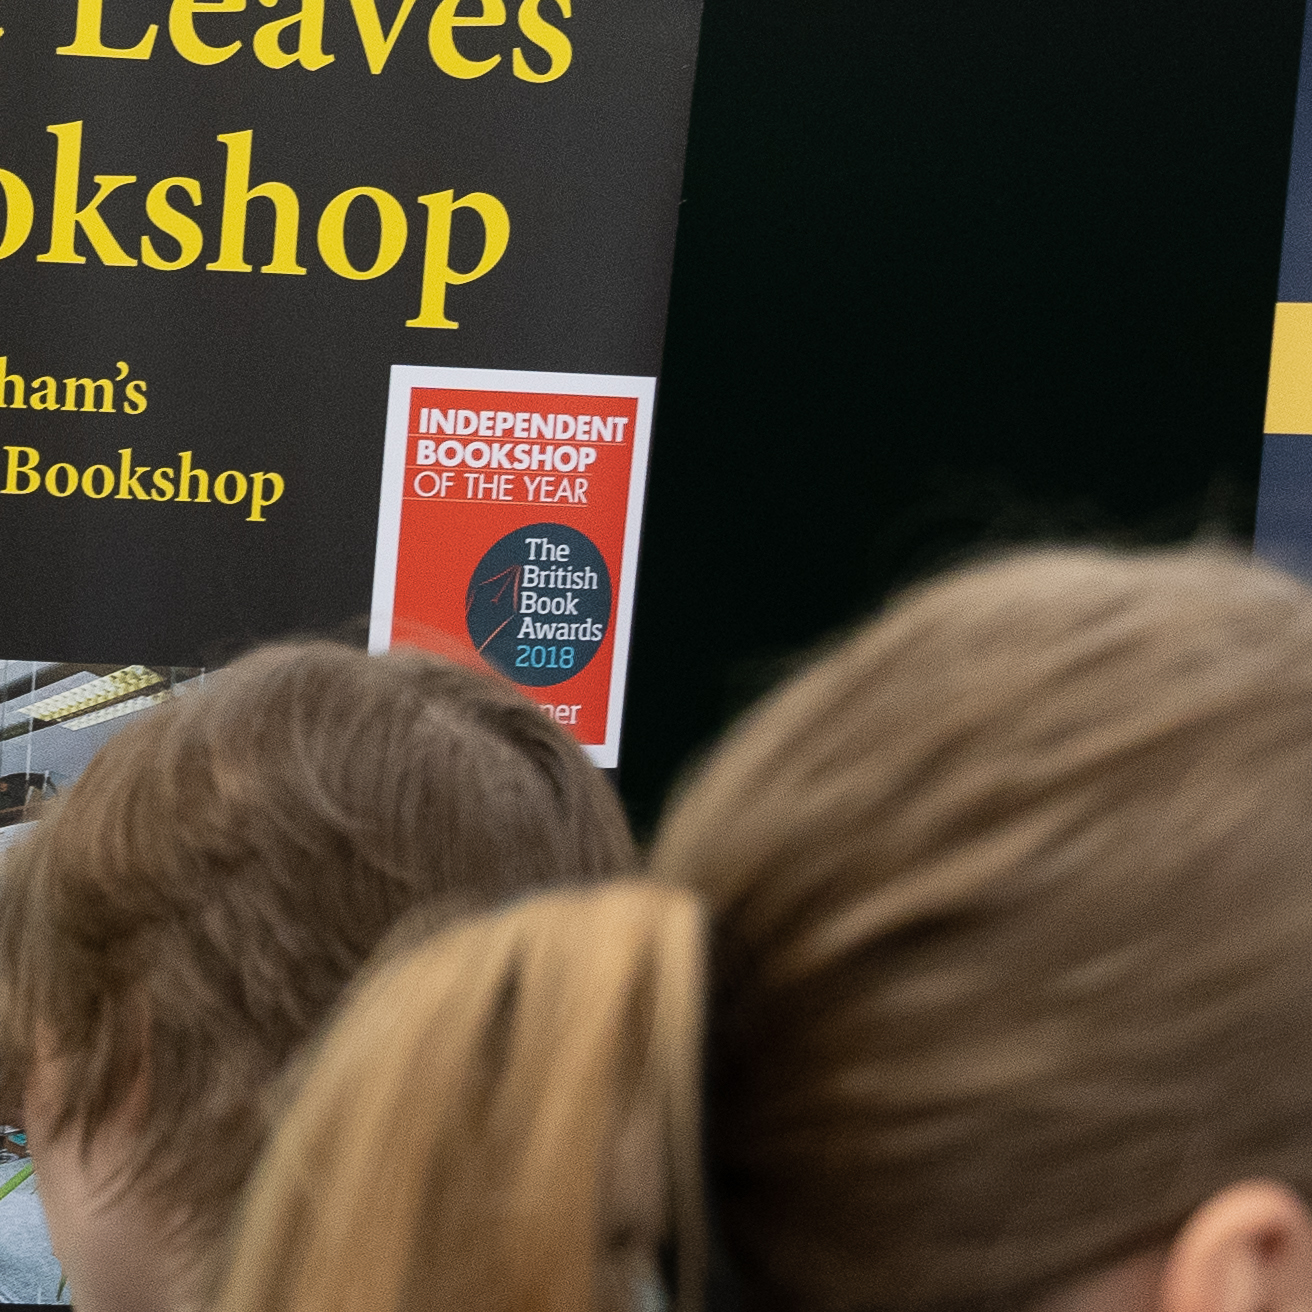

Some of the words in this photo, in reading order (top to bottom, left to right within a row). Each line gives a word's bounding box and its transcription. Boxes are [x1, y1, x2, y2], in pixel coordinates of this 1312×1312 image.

[418, 406, 629, 444] INDEPENDENT
[416, 440, 597, 473] BOOKSHOP
[0, 445, 285, 522] Bookshop
[414, 470, 455, 498] OF
[463, 473, 515, 501] THE
[523, 475, 588, 504] YEAR
[525, 536, 570, 562] The
[521, 564, 599, 590] British
[519, 591, 580, 616] Book
[516, 617, 603, 642] Awards
[515, 645, 575, 669] 2018
